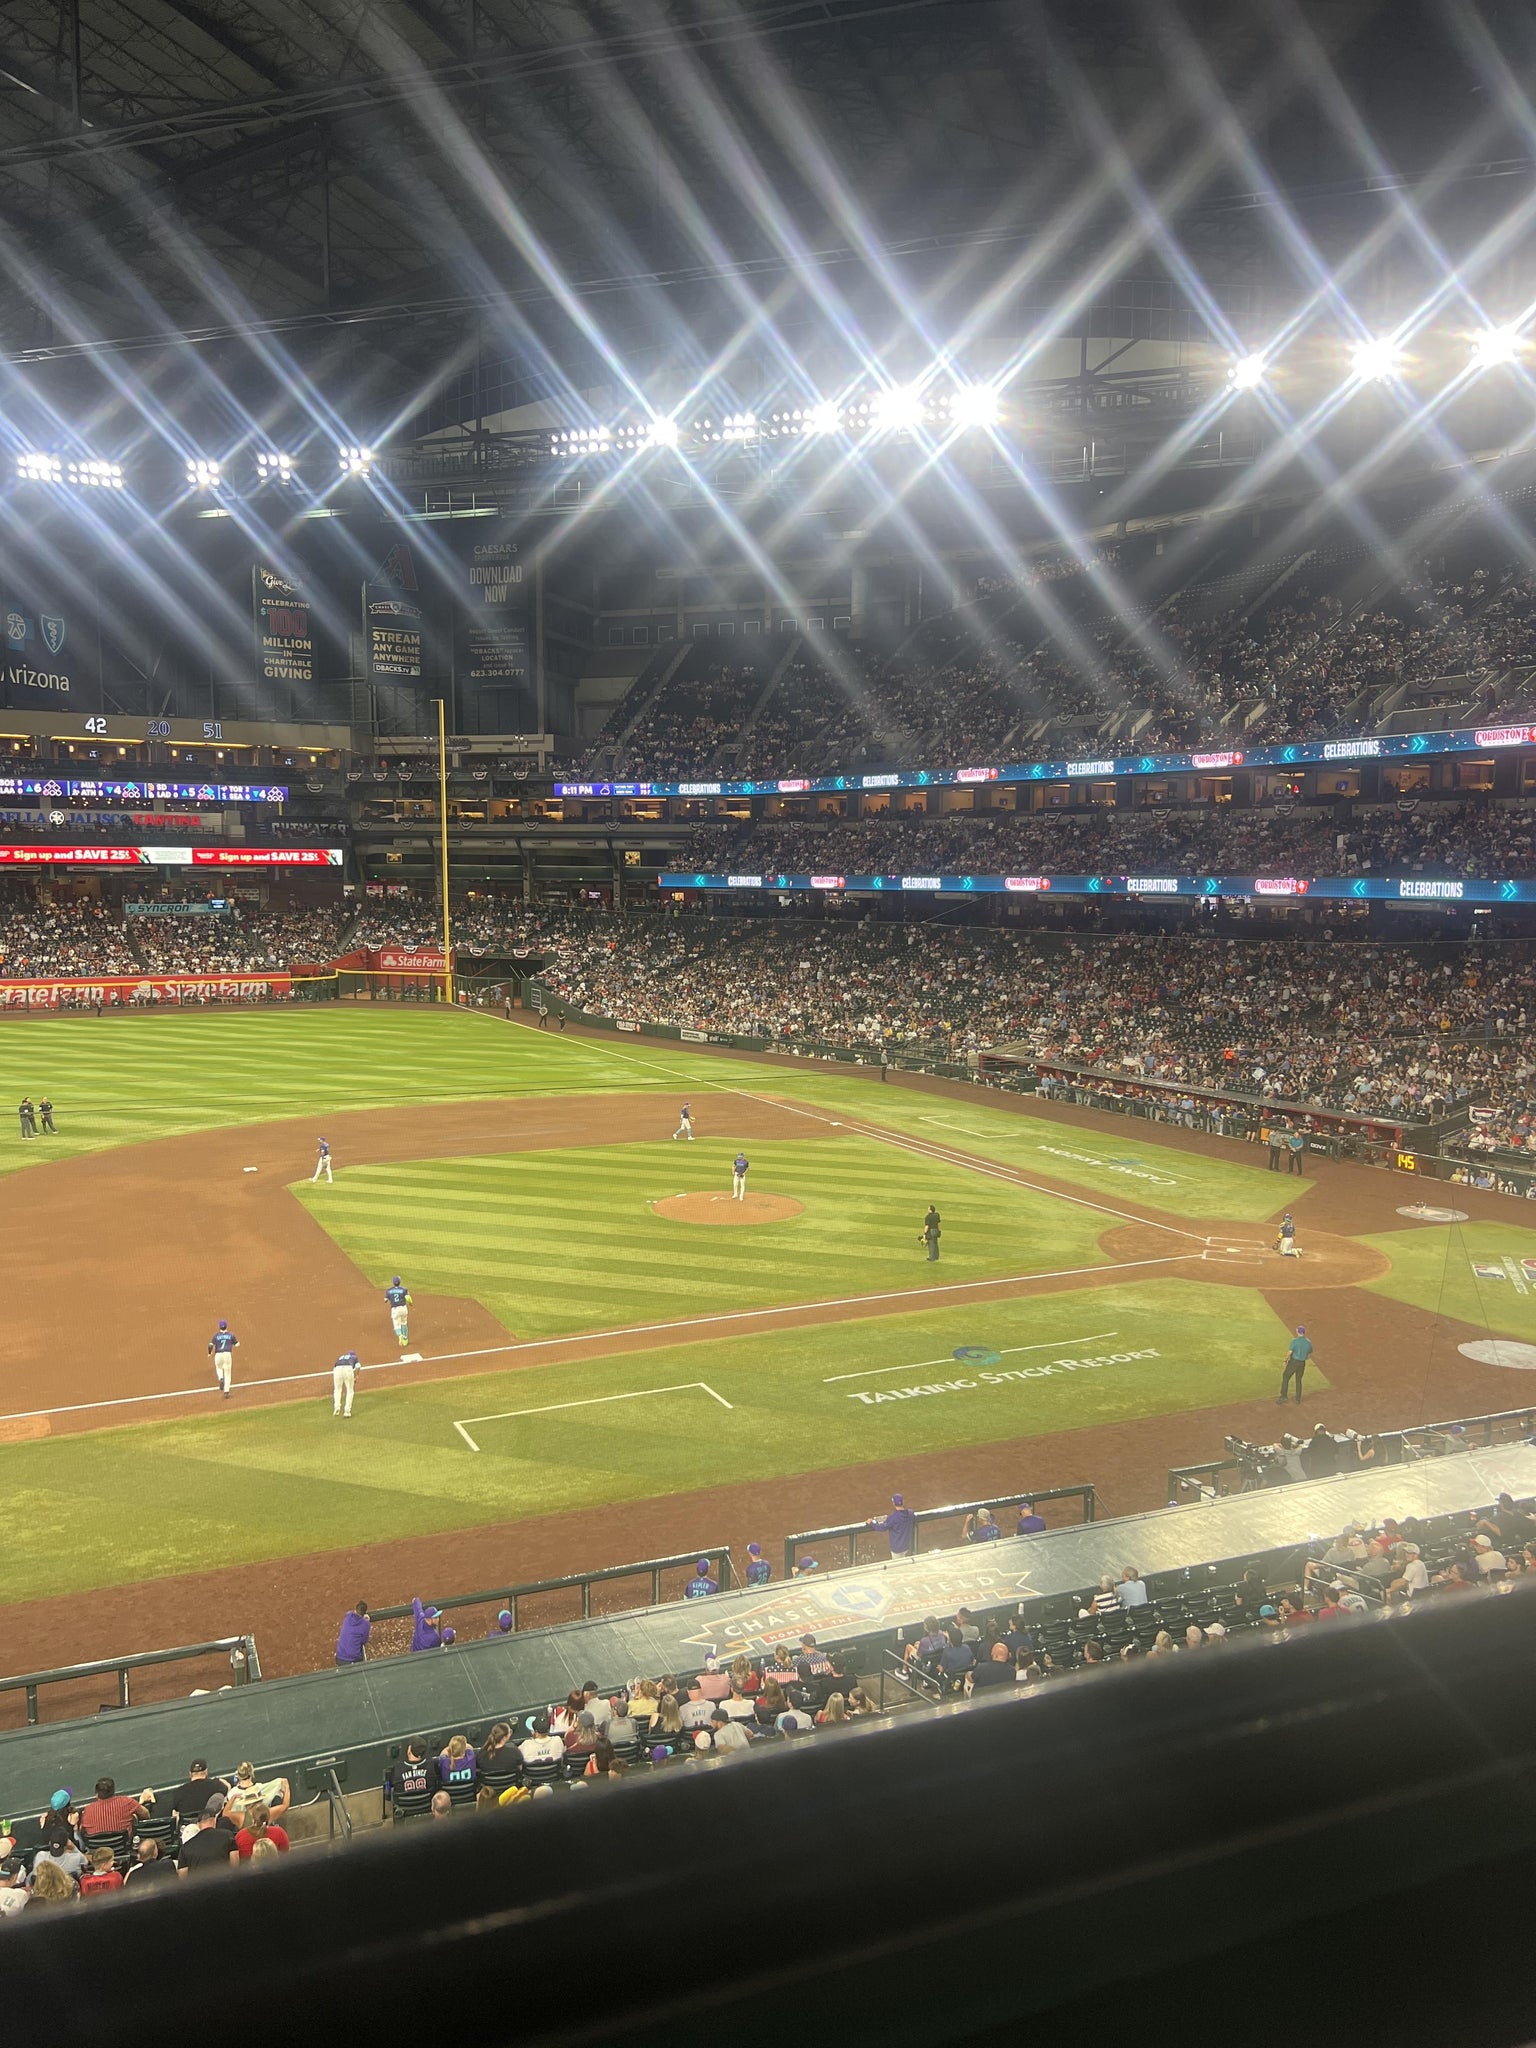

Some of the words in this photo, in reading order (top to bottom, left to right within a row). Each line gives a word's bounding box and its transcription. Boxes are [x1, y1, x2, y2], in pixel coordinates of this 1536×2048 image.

[474, 544, 518, 555] CAESARS
[469, 566, 522, 585] DOWNLOAD
[484, 585, 507, 603] NOW
[262, 598, 311, 609] CELEBRATING
[263, 637, 312, 650] MILLION
[372, 631, 420, 645] STREAM
[373, 643, 392, 652] ANY
[395, 645, 420, 655] GAME
[264, 657, 312, 667] CHARITABLE
[373, 653, 420, 664] ANYWHERE
[0, 664, 70, 692] Arizona
[264, 666, 312, 680] GIVING
[85, 717, 108, 735] 42
[147, 721, 171, 737] 20
[203, 722, 223, 740] 51
[1324, 741, 1379, 758] CELEBRATIONS
[1067, 761, 1114, 775] CELEBRATIONS
[862, 775, 899, 786] CELEBRATIONS
[33, 784, 42, 793] 6
[113, 785, 121, 794] 4
[188, 788, 196, 797] 5
[258, 789, 267, 798] 4
[578, 786, 593, 795] PM
[679, 784, 721, 795] CELEBRATIONS
[133, 814, 201, 826] CANTINA
[13, 850, 37, 861] Sign
[38, 852, 53, 861] up
[54, 851, 73, 860] and
[75, 850, 109, 859] SAVE
[219, 853, 239, 862] Sign
[240, 854, 252, 863] up
[253, 853, 270, 861] and
[271, 852, 300, 861] SAVE
[728, 876, 762, 886] CELEBRATIONS
[902, 876, 941, 889] CELEBRATIONS
[1127, 879, 1178, 892] CELEBRATIONS
[1400, 881, 1463, 897] CELEBRATIONS
[137, 904, 189, 913] SYNCRON
[393, 1293, 400, 1302] 2
[219, 1340, 227, 1349] 7
[848, 1379, 977, 1405] TALKING
[978, 1365, 1063, 1385] STICK
[1053, 1348, 1162, 1372] RESORT
[724, 1606, 818, 1636] CHASE
[903, 1576, 994, 1597] FIELD
[769, 1628, 801, 1640] HOME
[401, 1772, 413, 1781] FAN
